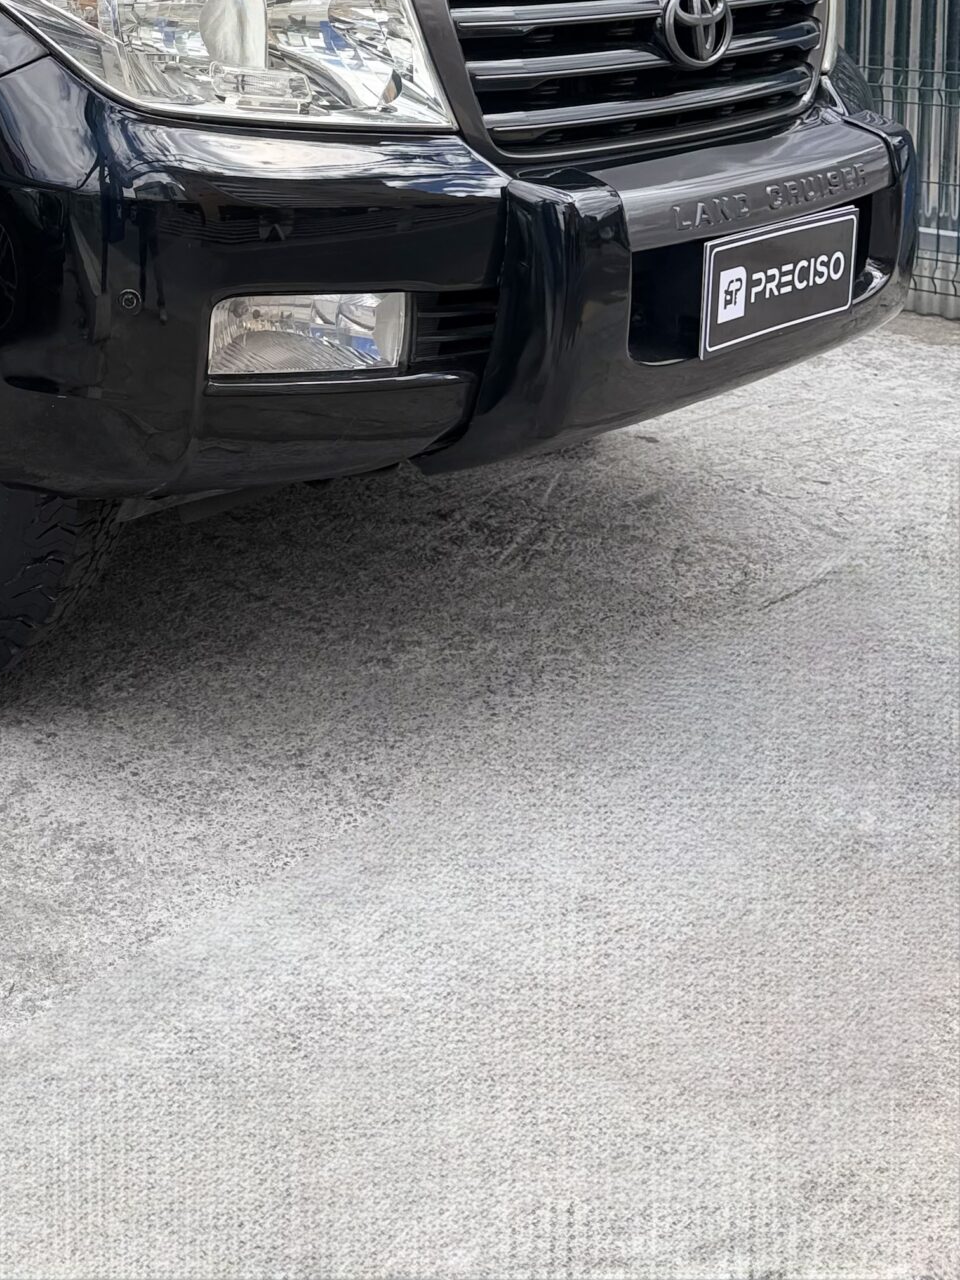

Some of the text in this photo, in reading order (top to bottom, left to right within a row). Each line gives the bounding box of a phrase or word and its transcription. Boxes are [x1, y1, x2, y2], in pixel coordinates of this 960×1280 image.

[672, 162, 869, 232] LAND CRUISER
[749, 250, 846, 304] PRECISO
